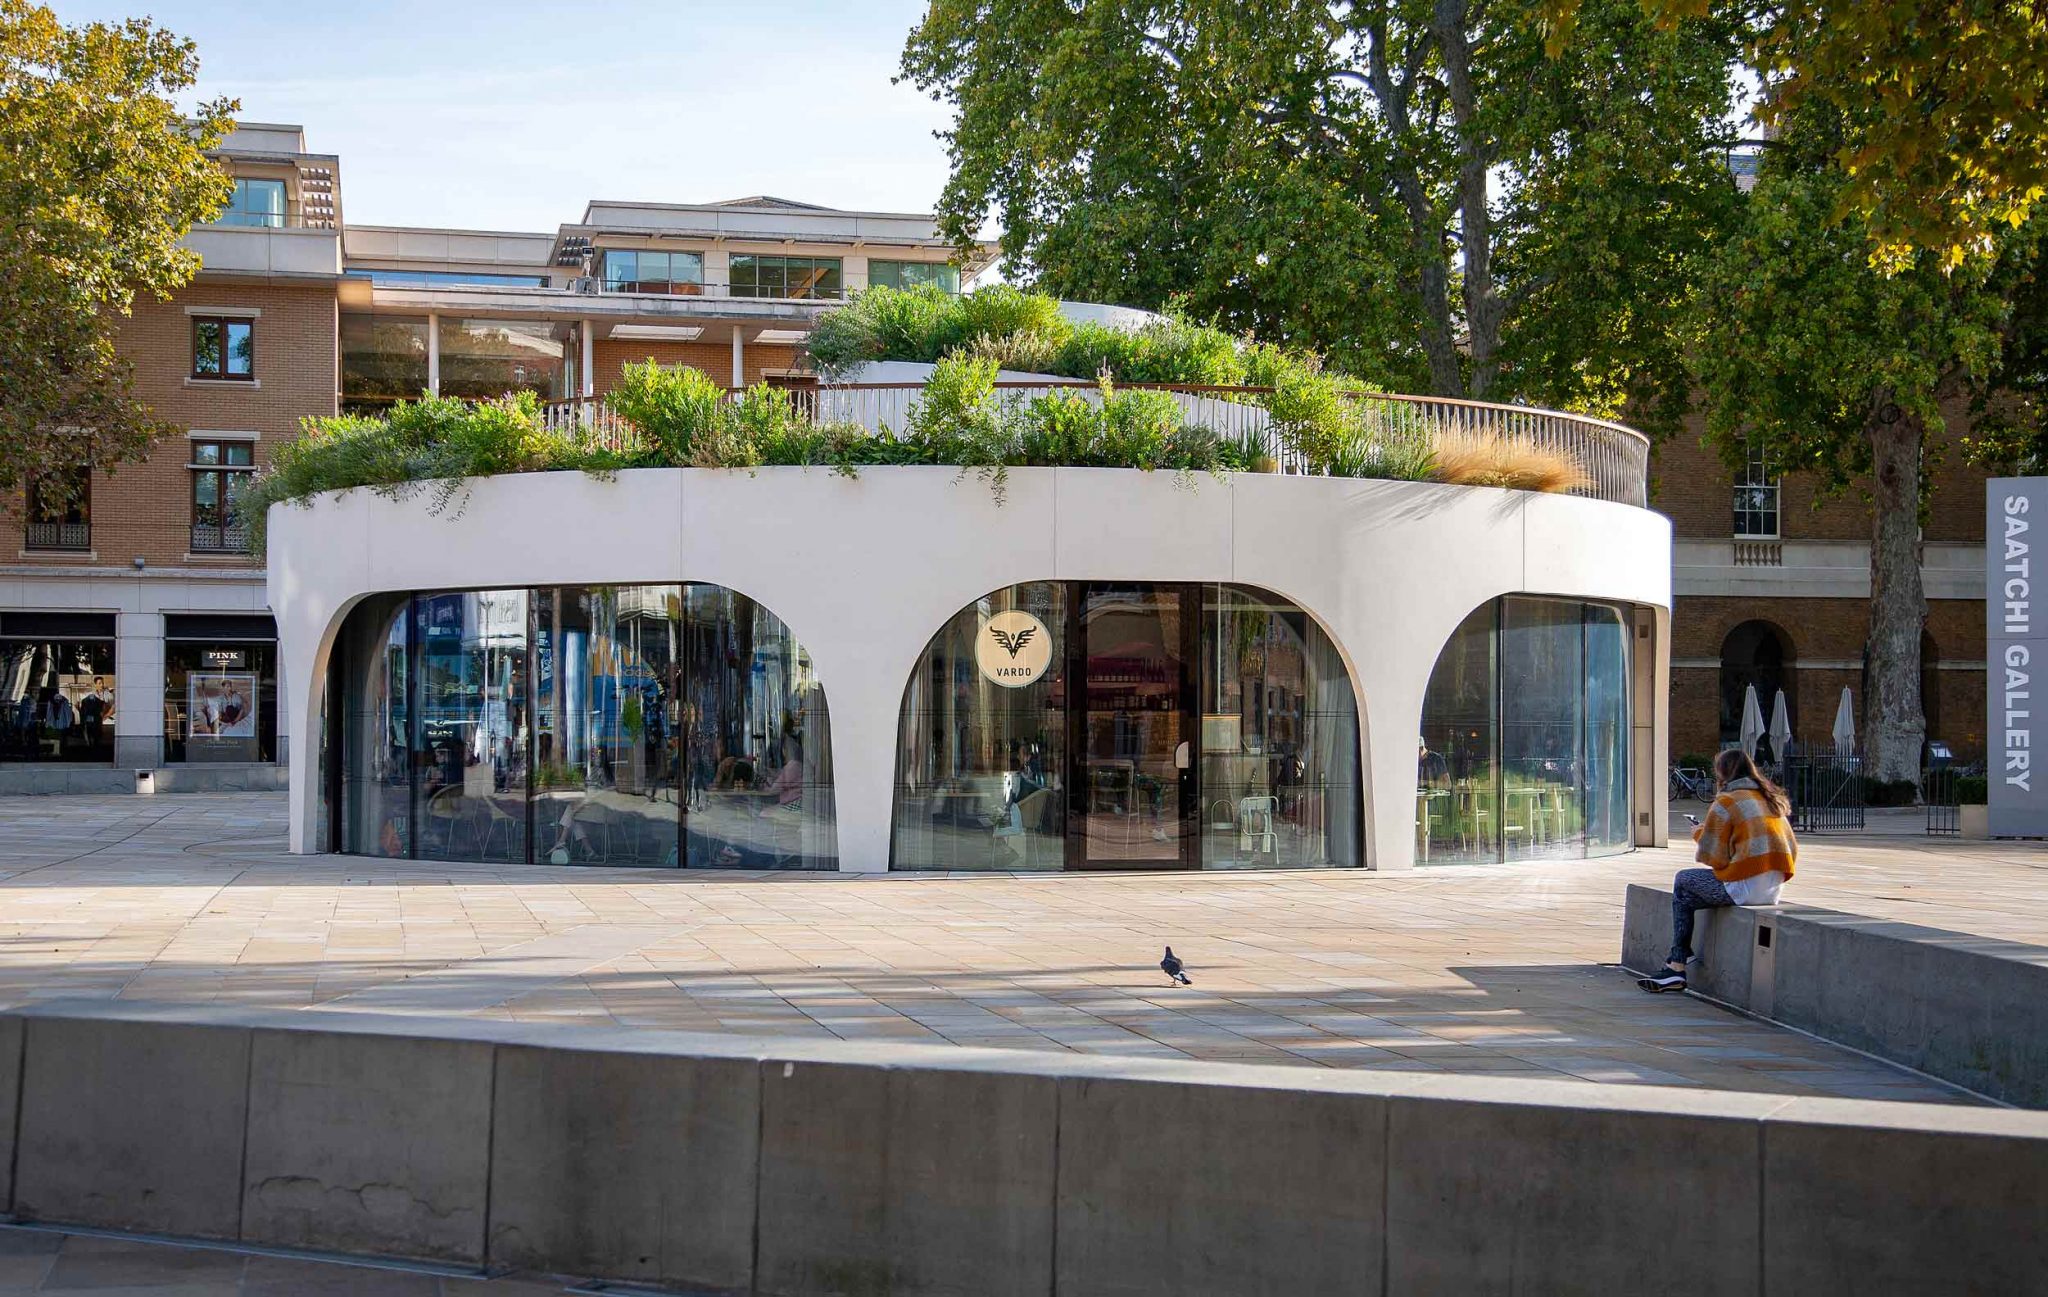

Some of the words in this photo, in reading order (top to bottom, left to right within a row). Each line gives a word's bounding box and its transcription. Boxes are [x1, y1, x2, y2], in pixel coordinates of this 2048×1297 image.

[2003, 495, 2030, 633] SAATCHI
[996, 667, 1032, 677] VARDO
[2004, 644, 2031, 792] GALLERY
